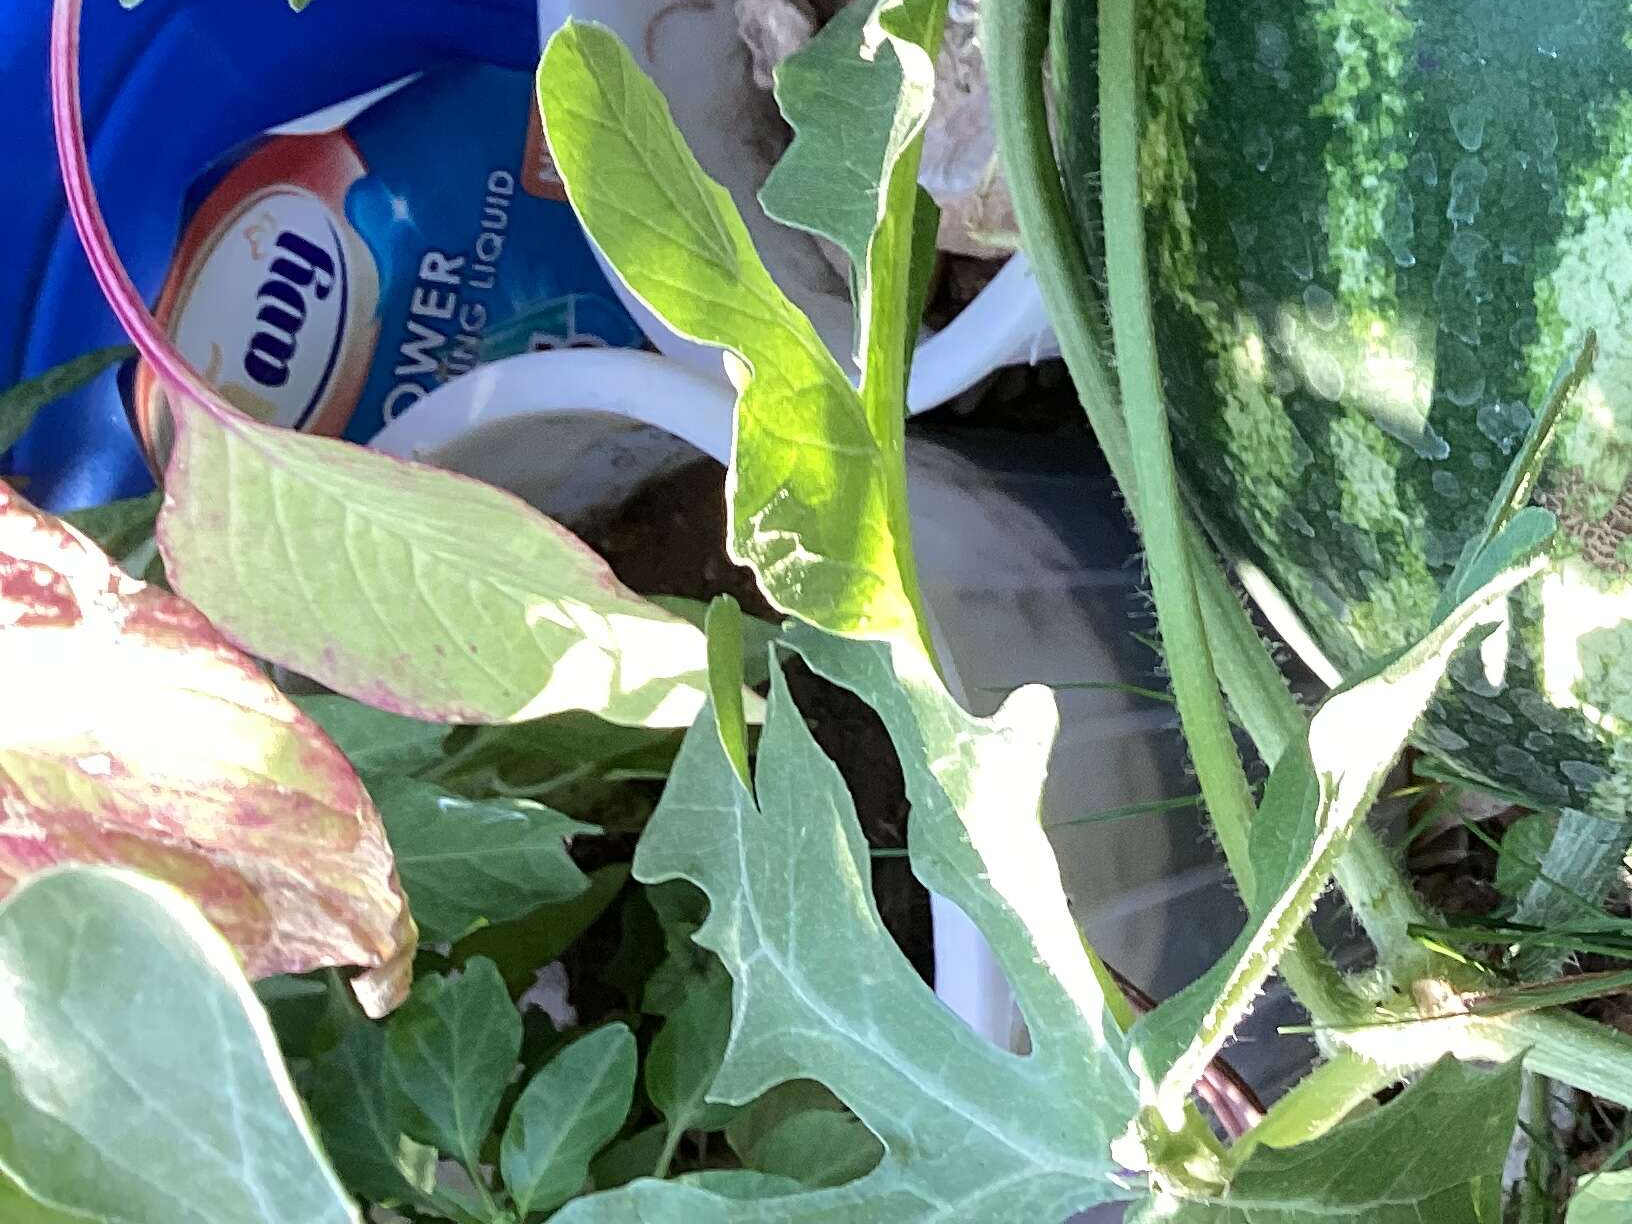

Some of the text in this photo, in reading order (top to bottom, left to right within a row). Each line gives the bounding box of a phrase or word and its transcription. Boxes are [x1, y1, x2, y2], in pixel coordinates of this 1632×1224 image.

[382, 249, 465, 426] OWER
[444, 169, 514, 384] ING LIQUID
